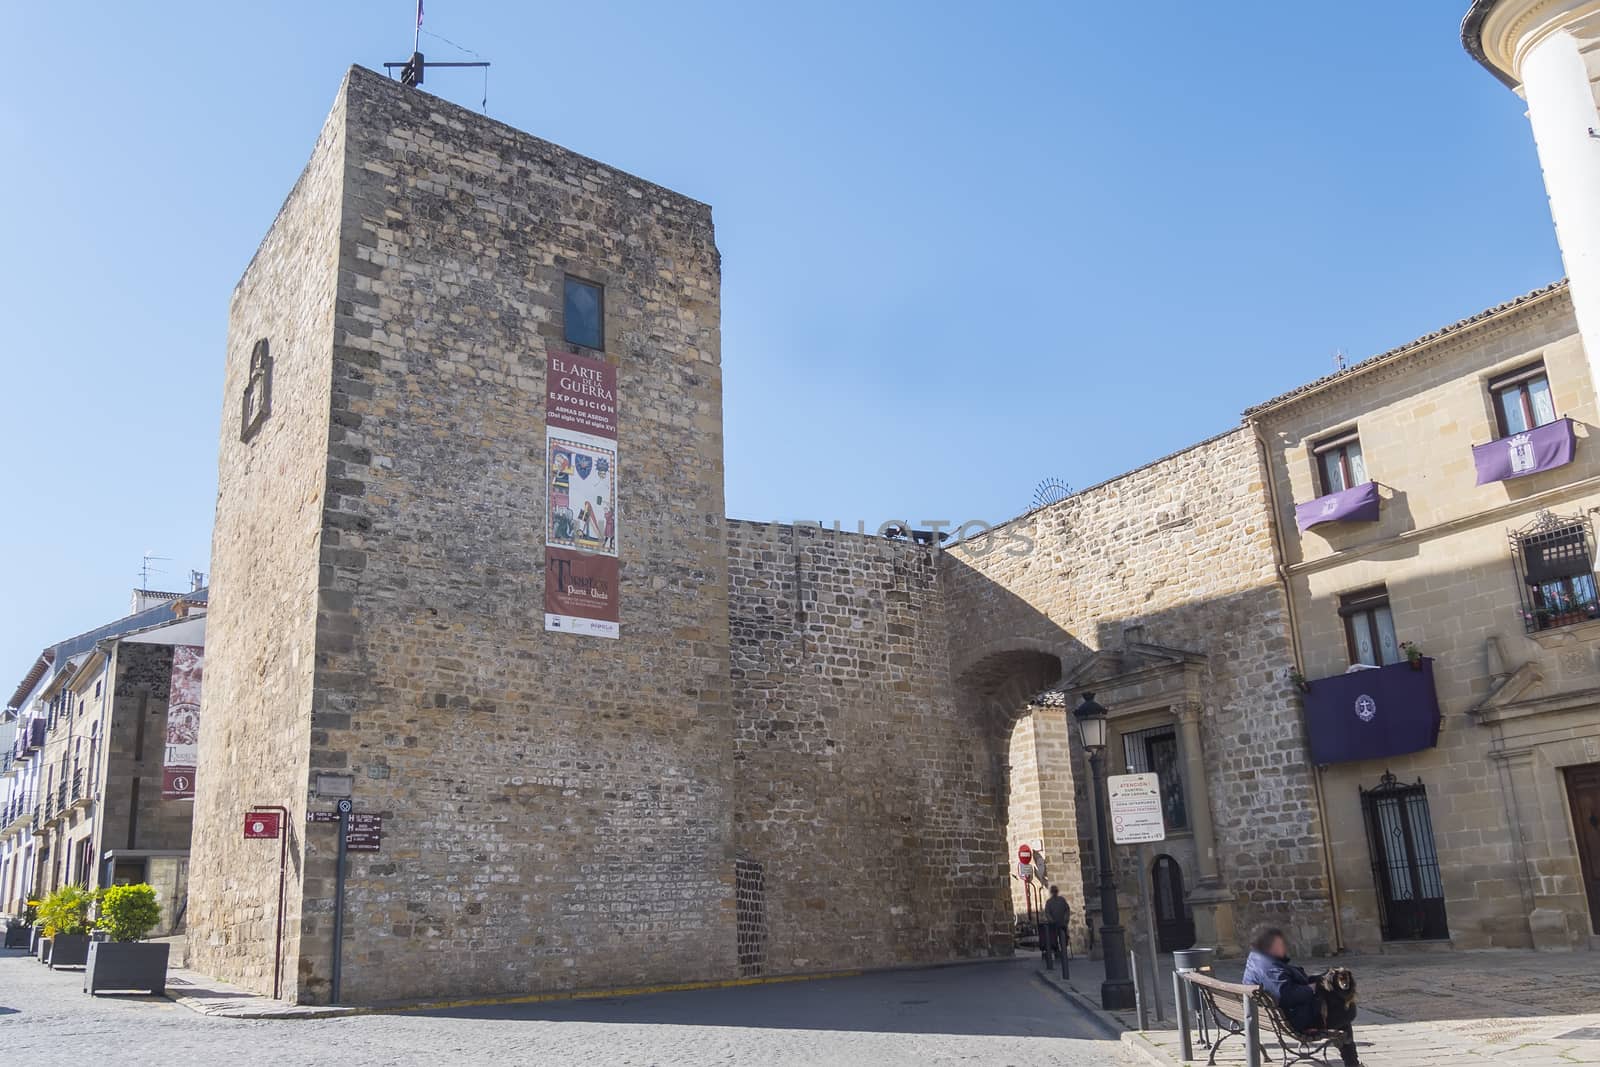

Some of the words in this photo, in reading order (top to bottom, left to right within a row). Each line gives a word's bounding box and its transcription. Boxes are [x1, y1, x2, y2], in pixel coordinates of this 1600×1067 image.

[553, 359, 567, 373] EL
[570, 364, 602, 382] ARTE
[560, 377, 613, 401] GUERRA
[550, 392, 614, 413] EXPOSICIÓN
[555, 406, 577, 415] ARMAS
[587, 413, 609, 423] ASEDIO
